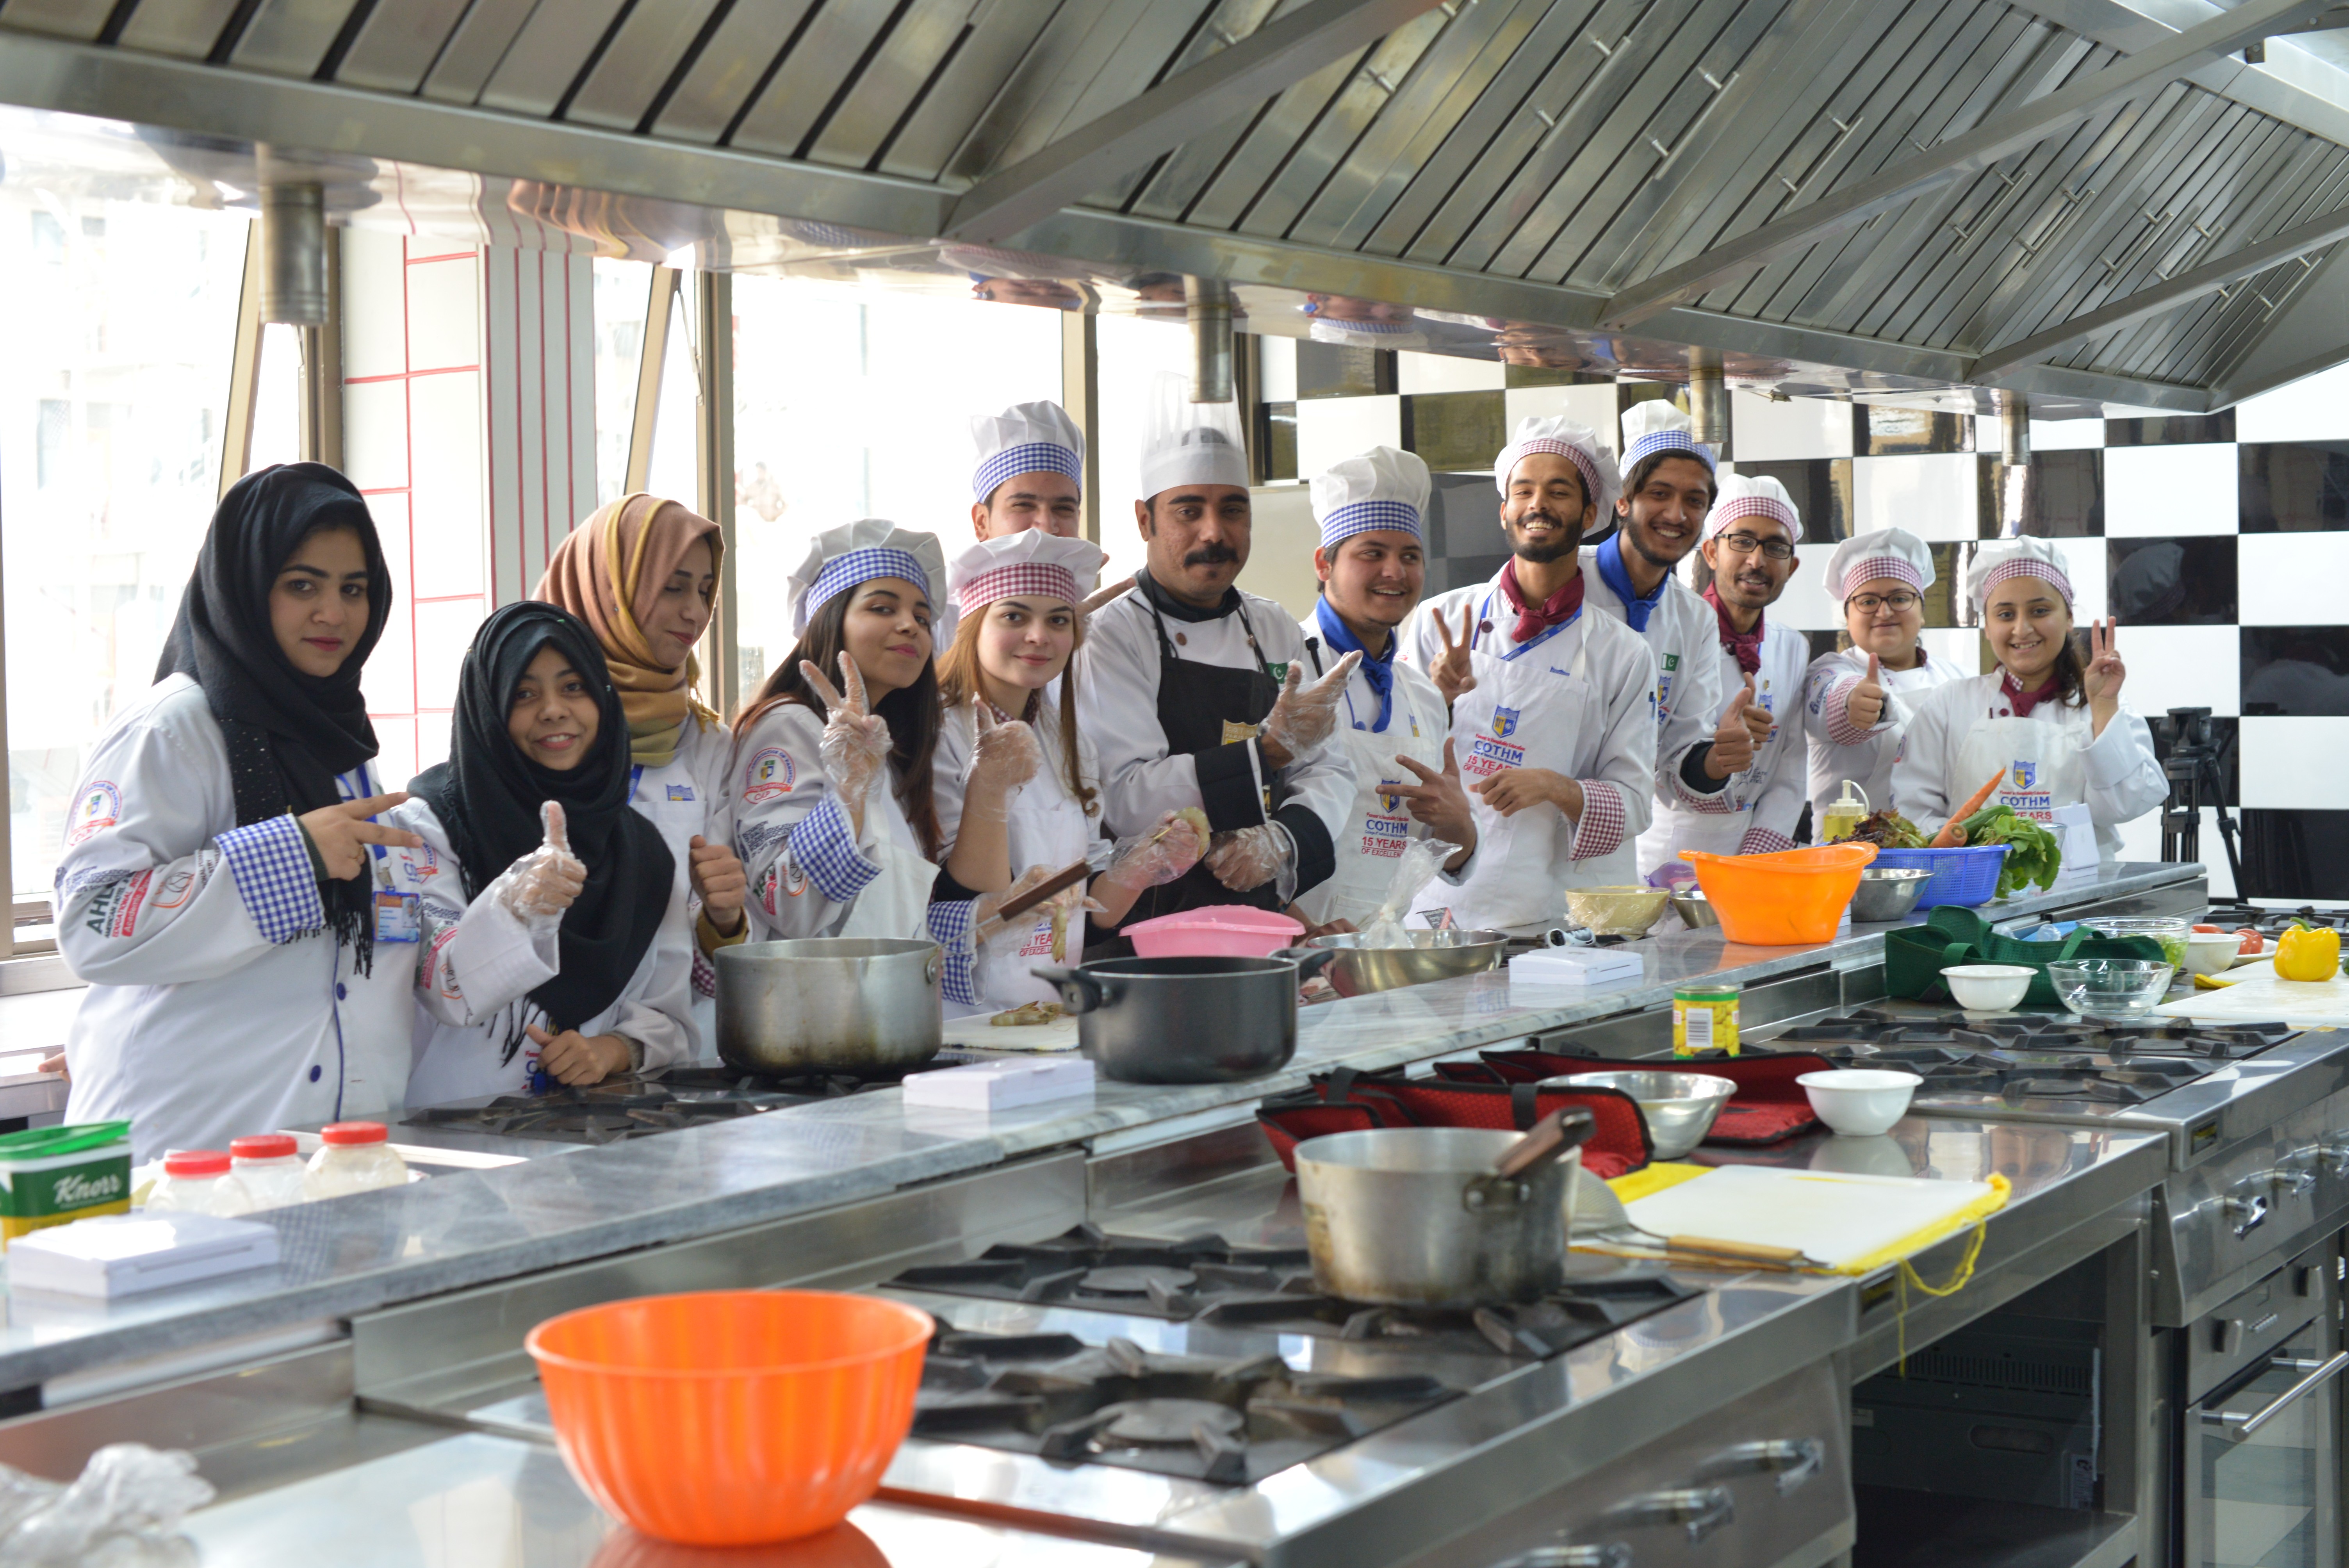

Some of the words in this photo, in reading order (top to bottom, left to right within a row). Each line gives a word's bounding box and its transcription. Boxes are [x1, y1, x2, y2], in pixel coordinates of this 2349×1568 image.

[1467, 755, 1478, 765] 15
[1475, 740, 1523, 763] COTHM
[2000, 796, 2050, 806] COTHM
[1366, 819, 1408, 834] COTHM
[1362, 836, 1374, 846] 15
[1377, 838, 1407, 850] YEARS
[104, 906, 117, 939] AMERICAN
[113, 886, 126, 905] HOTEL
[112, 890, 133, 937] EDUCATIONAL
[124, 894, 143, 933] Academic
[52, 1173, 123, 1204] Knorr
